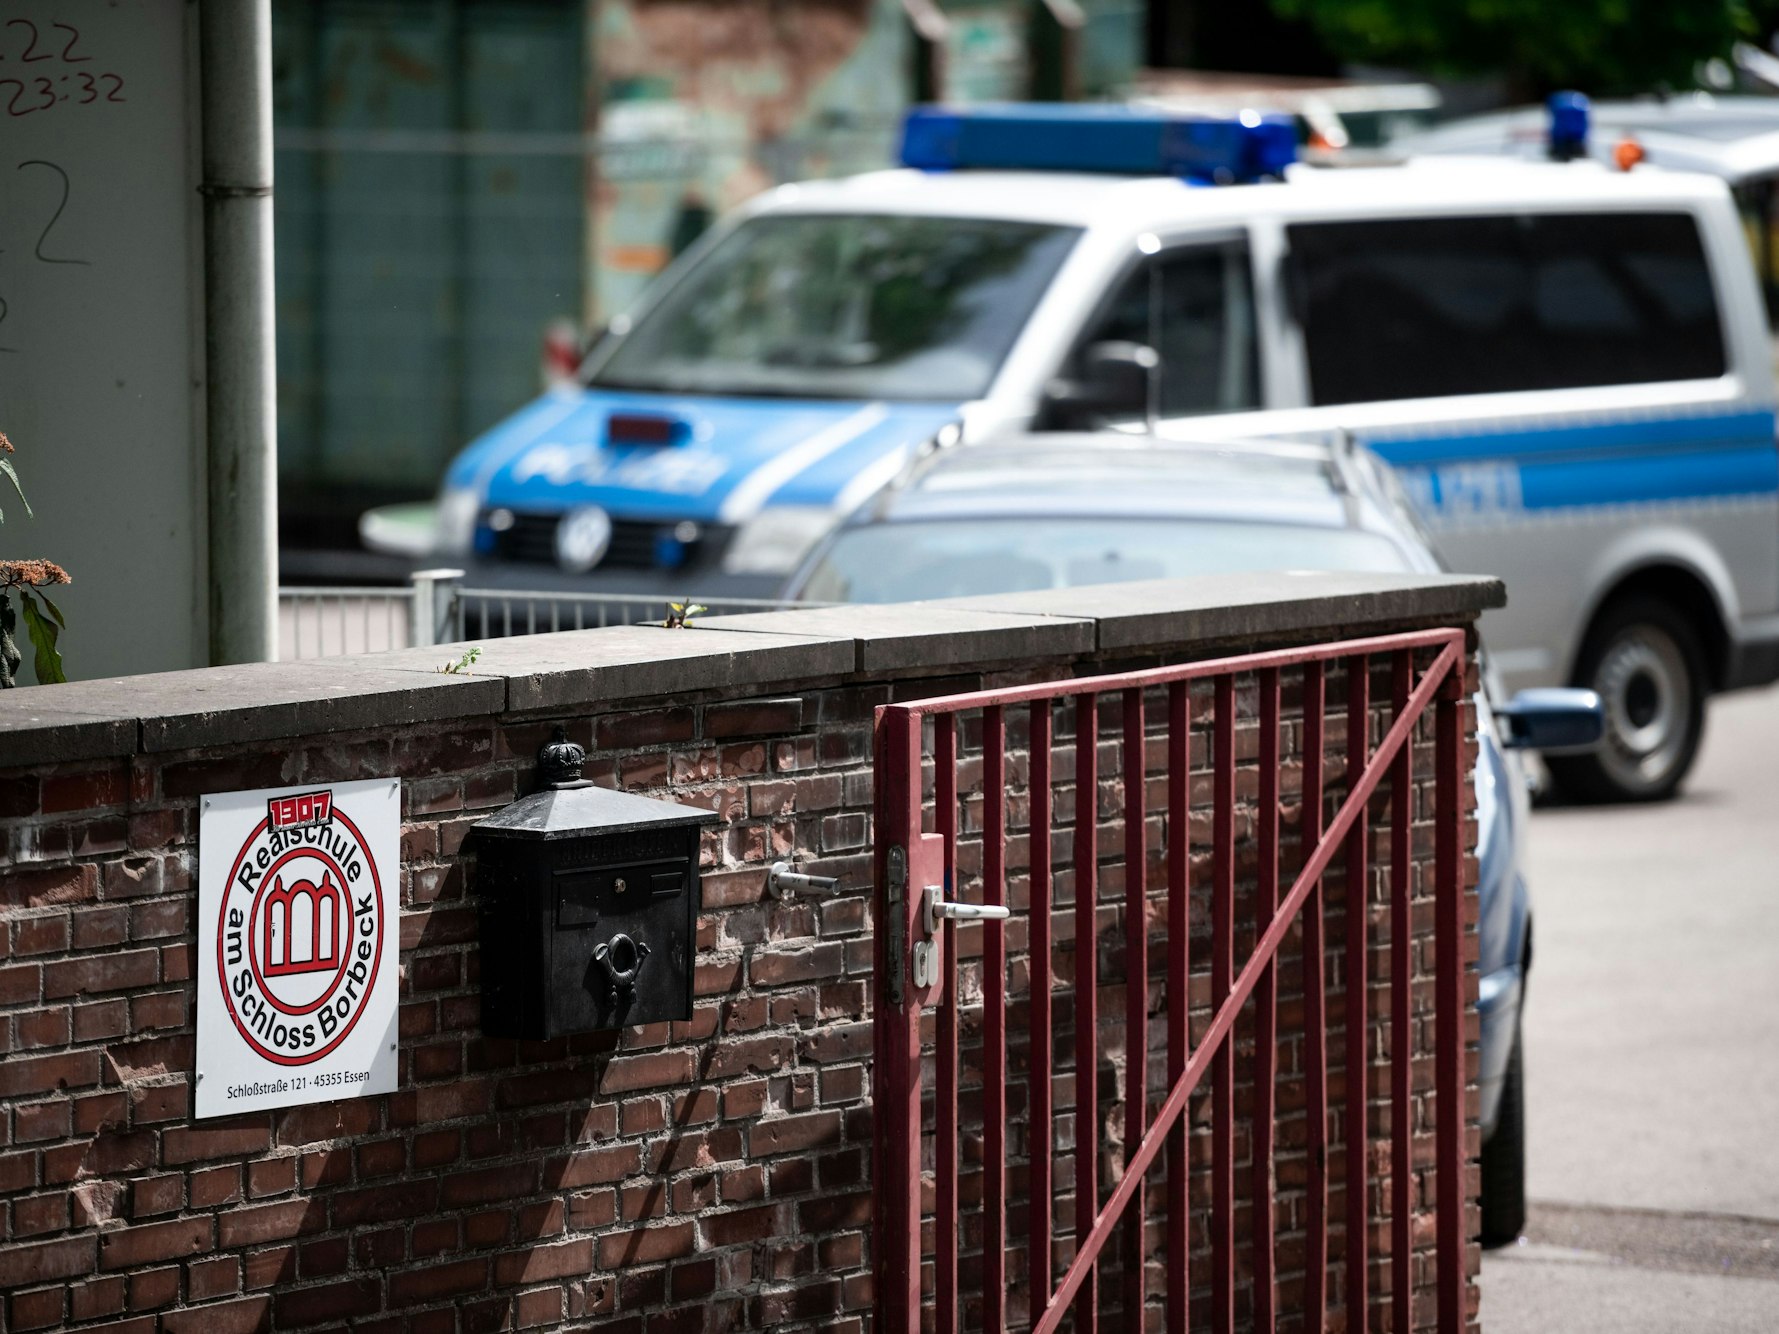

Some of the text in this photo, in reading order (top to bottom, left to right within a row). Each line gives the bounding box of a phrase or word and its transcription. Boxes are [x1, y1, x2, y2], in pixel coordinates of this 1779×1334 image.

[0, 72, 127, 117] 23:32
[0, 160, 92, 266] 2
[269, 791, 332, 828] 1907
[237, 824, 362, 894] Realschule
[226, 892, 374, 1050] am Schloss Borbeck
[227, 1070, 370, 1099] Schloßstraße 121 45355 Essen
